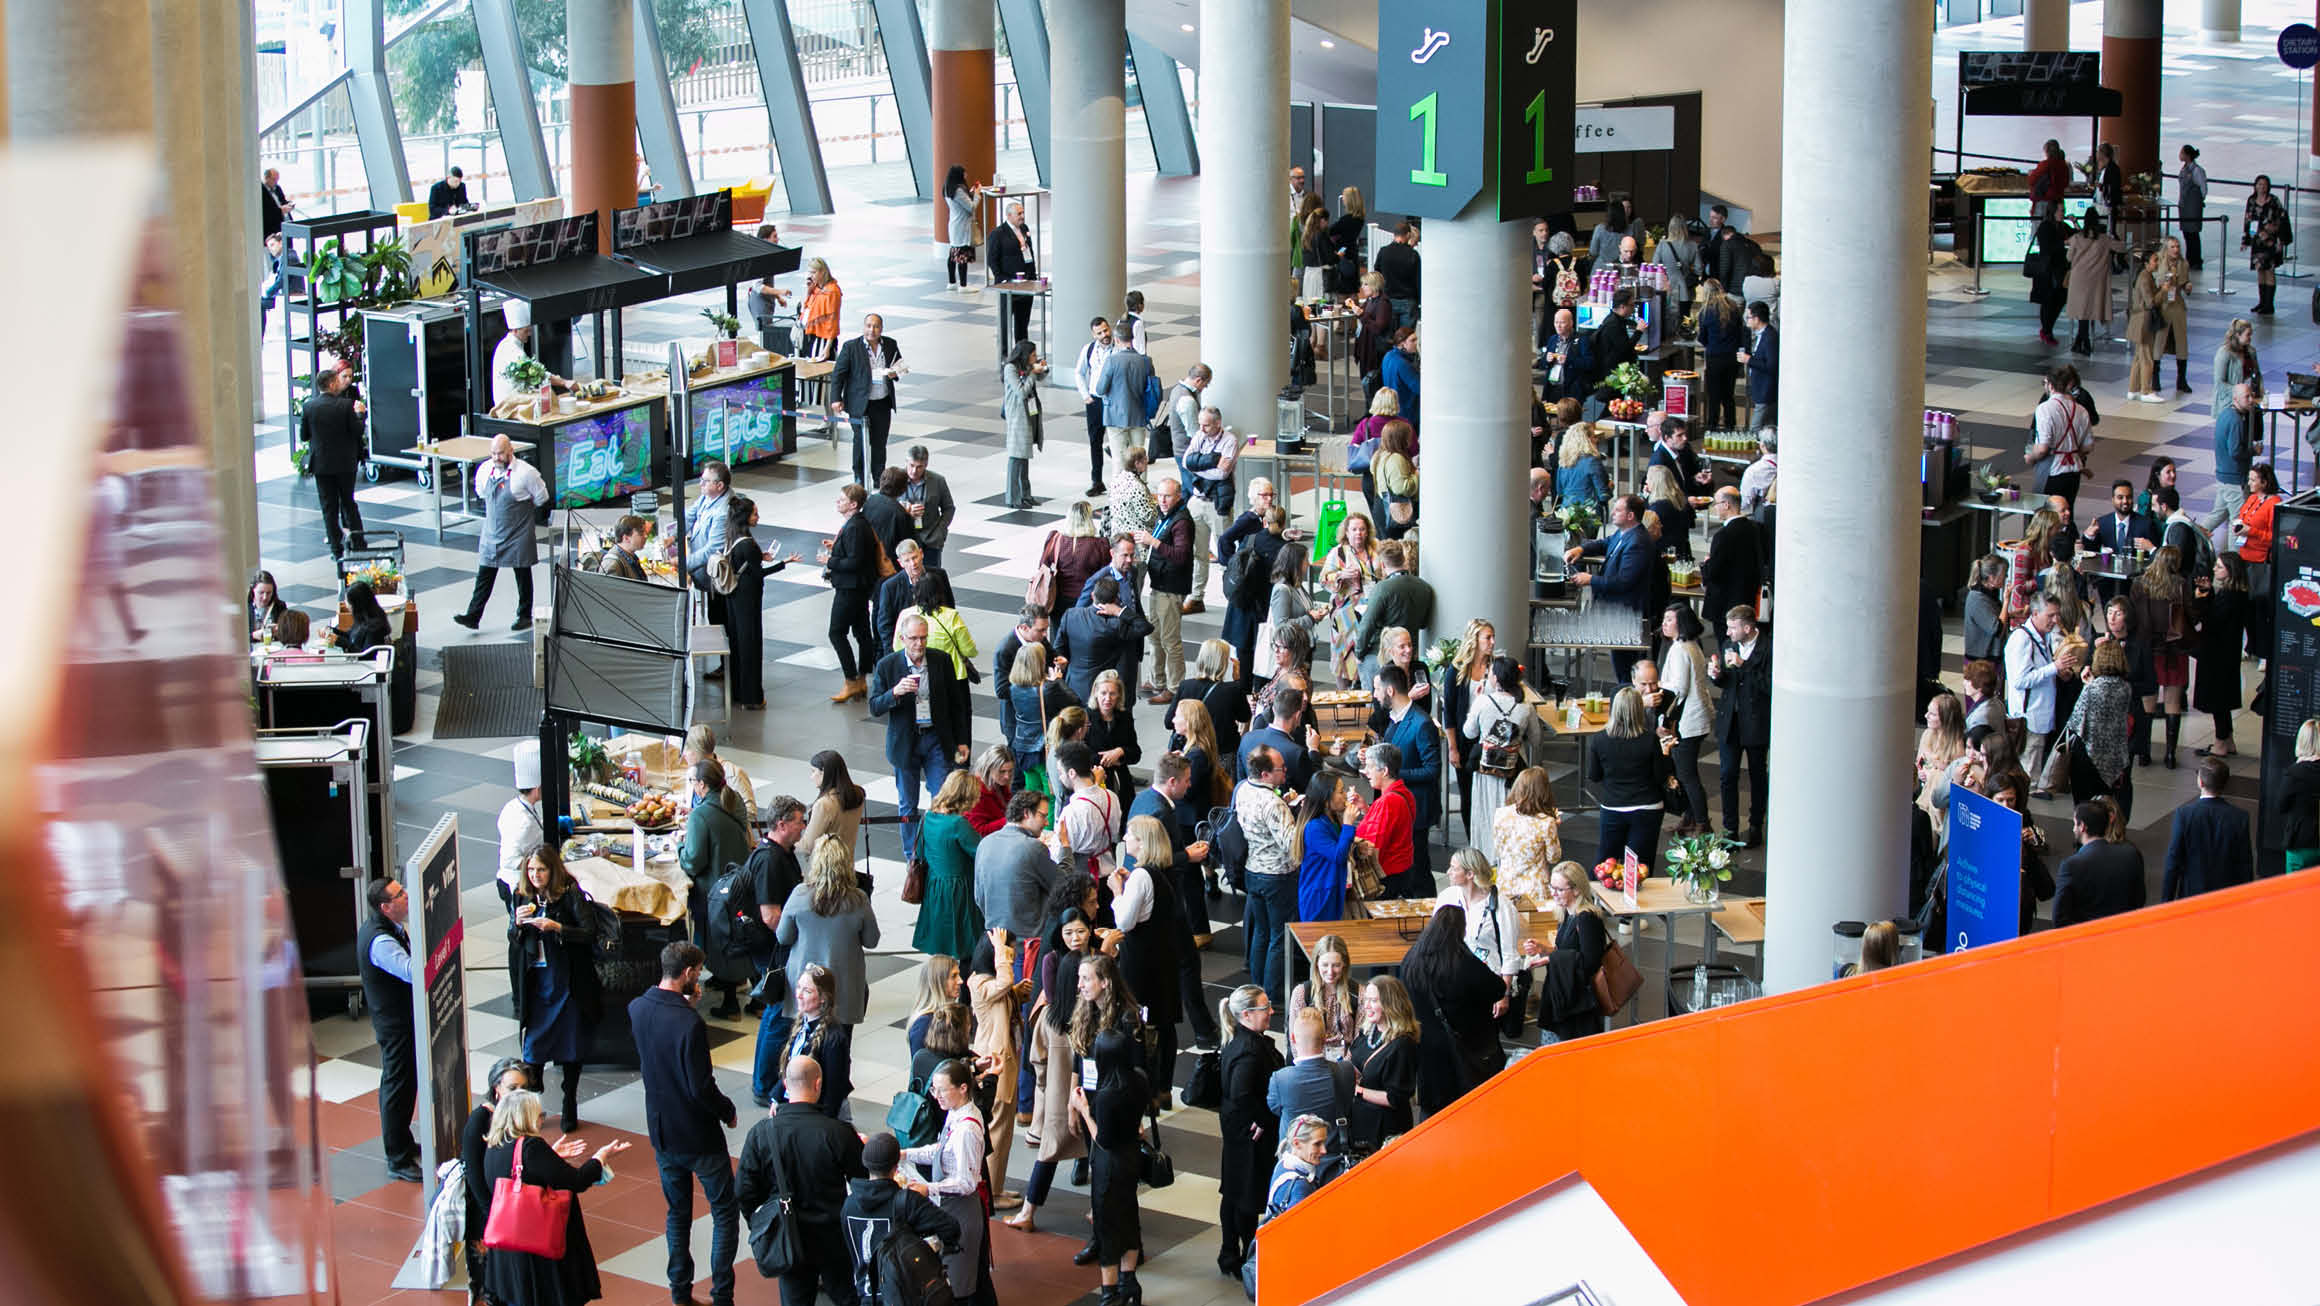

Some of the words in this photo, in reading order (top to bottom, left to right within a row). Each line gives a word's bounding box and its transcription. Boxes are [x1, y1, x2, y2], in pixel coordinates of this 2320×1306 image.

[1409, 91, 1447, 187] 1
[1525, 89, 1553, 185] 1
[1576, 123, 1616, 138] ffee
[704, 409, 772, 451] Eats
[568, 435, 623, 488] Eat
[434, 937, 447, 970] Level
